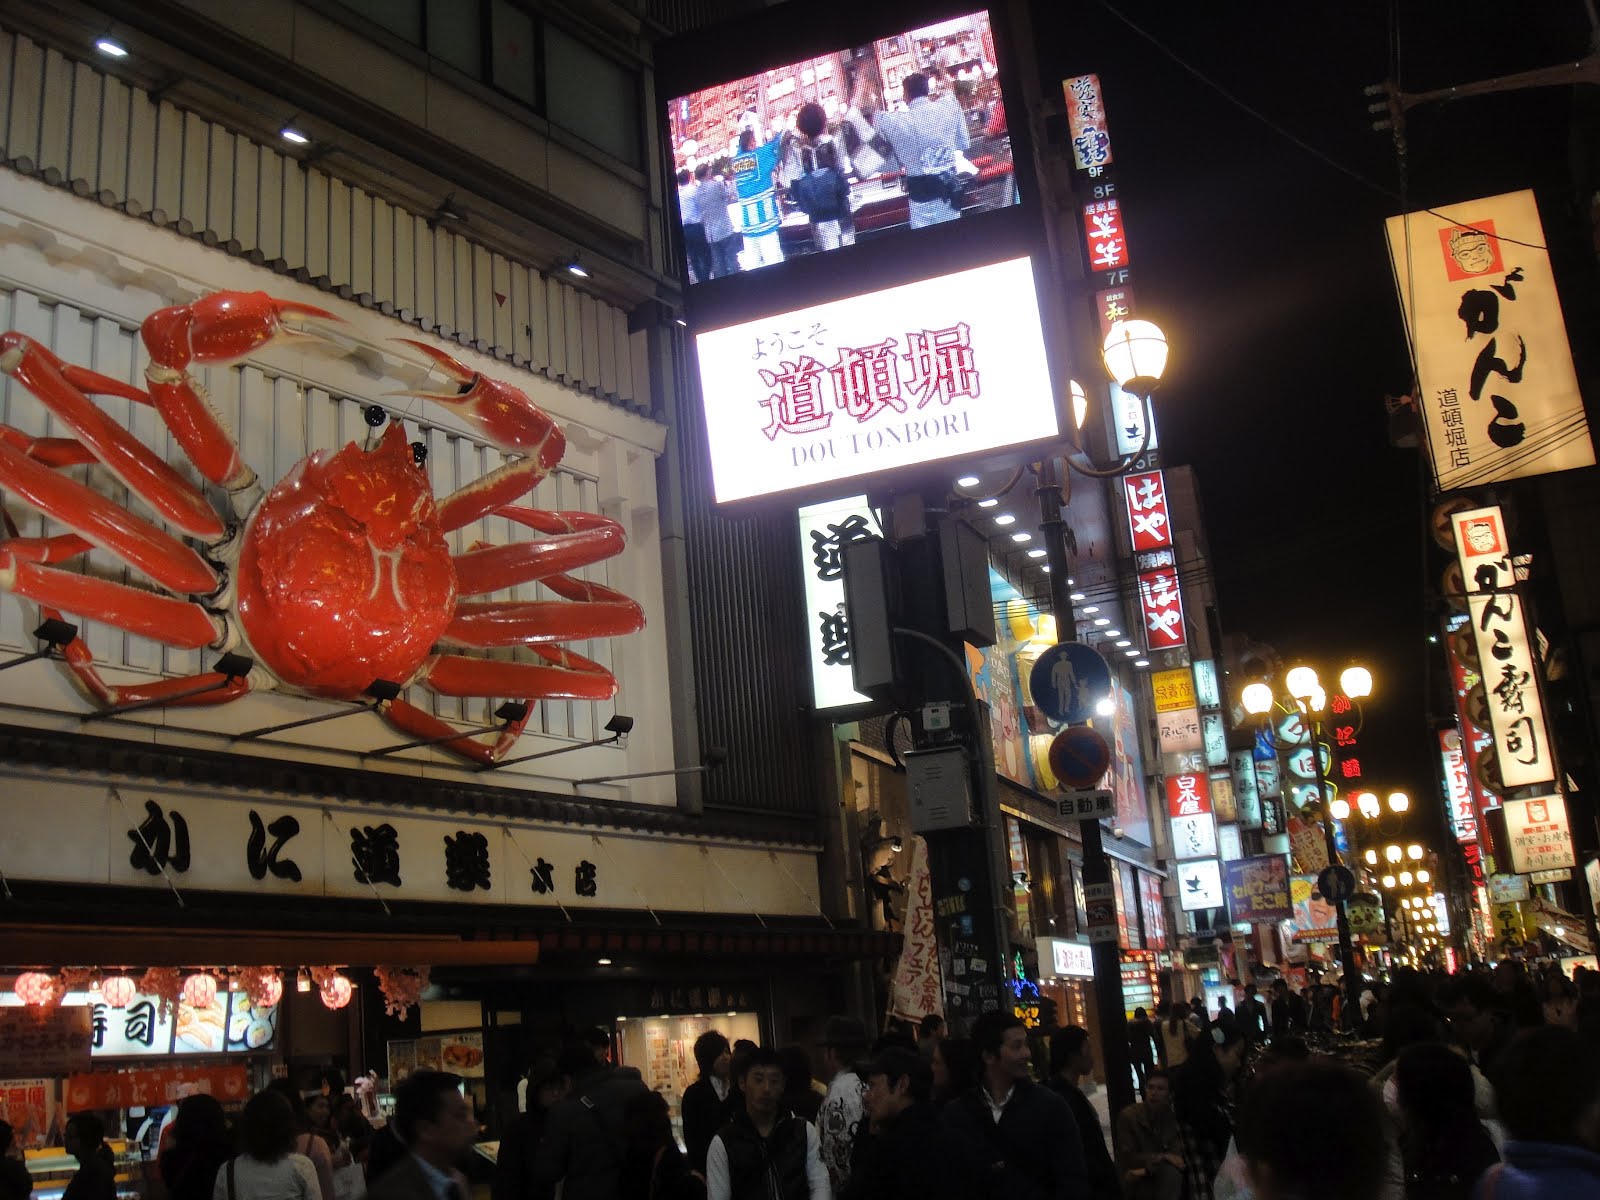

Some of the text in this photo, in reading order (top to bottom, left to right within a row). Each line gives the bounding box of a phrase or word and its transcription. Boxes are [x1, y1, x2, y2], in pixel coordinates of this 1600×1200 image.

[1088, 165, 1104, 178] 9F
[1093, 183, 1116, 199] 8F
[1106, 269, 1129, 285] 7F
[751, 322, 829, 360] ようこそ
[1457, 266, 1527, 448] がんこ
[757, 321, 981, 441] 道頓堀
[791, 410, 973, 467] DOUTONBORI
[1436, 388, 1470, 468] 道頓堀店
[1128, 478, 1166, 542] はや
[1138, 550, 1173, 569] 焼肉
[1143, 575, 1181, 641] はや
[1059, 796, 1111, 815] 自動車
[1176, 776, 1203, 815] 白木屋
[128, 799, 597, 897] かに道楽 本店
